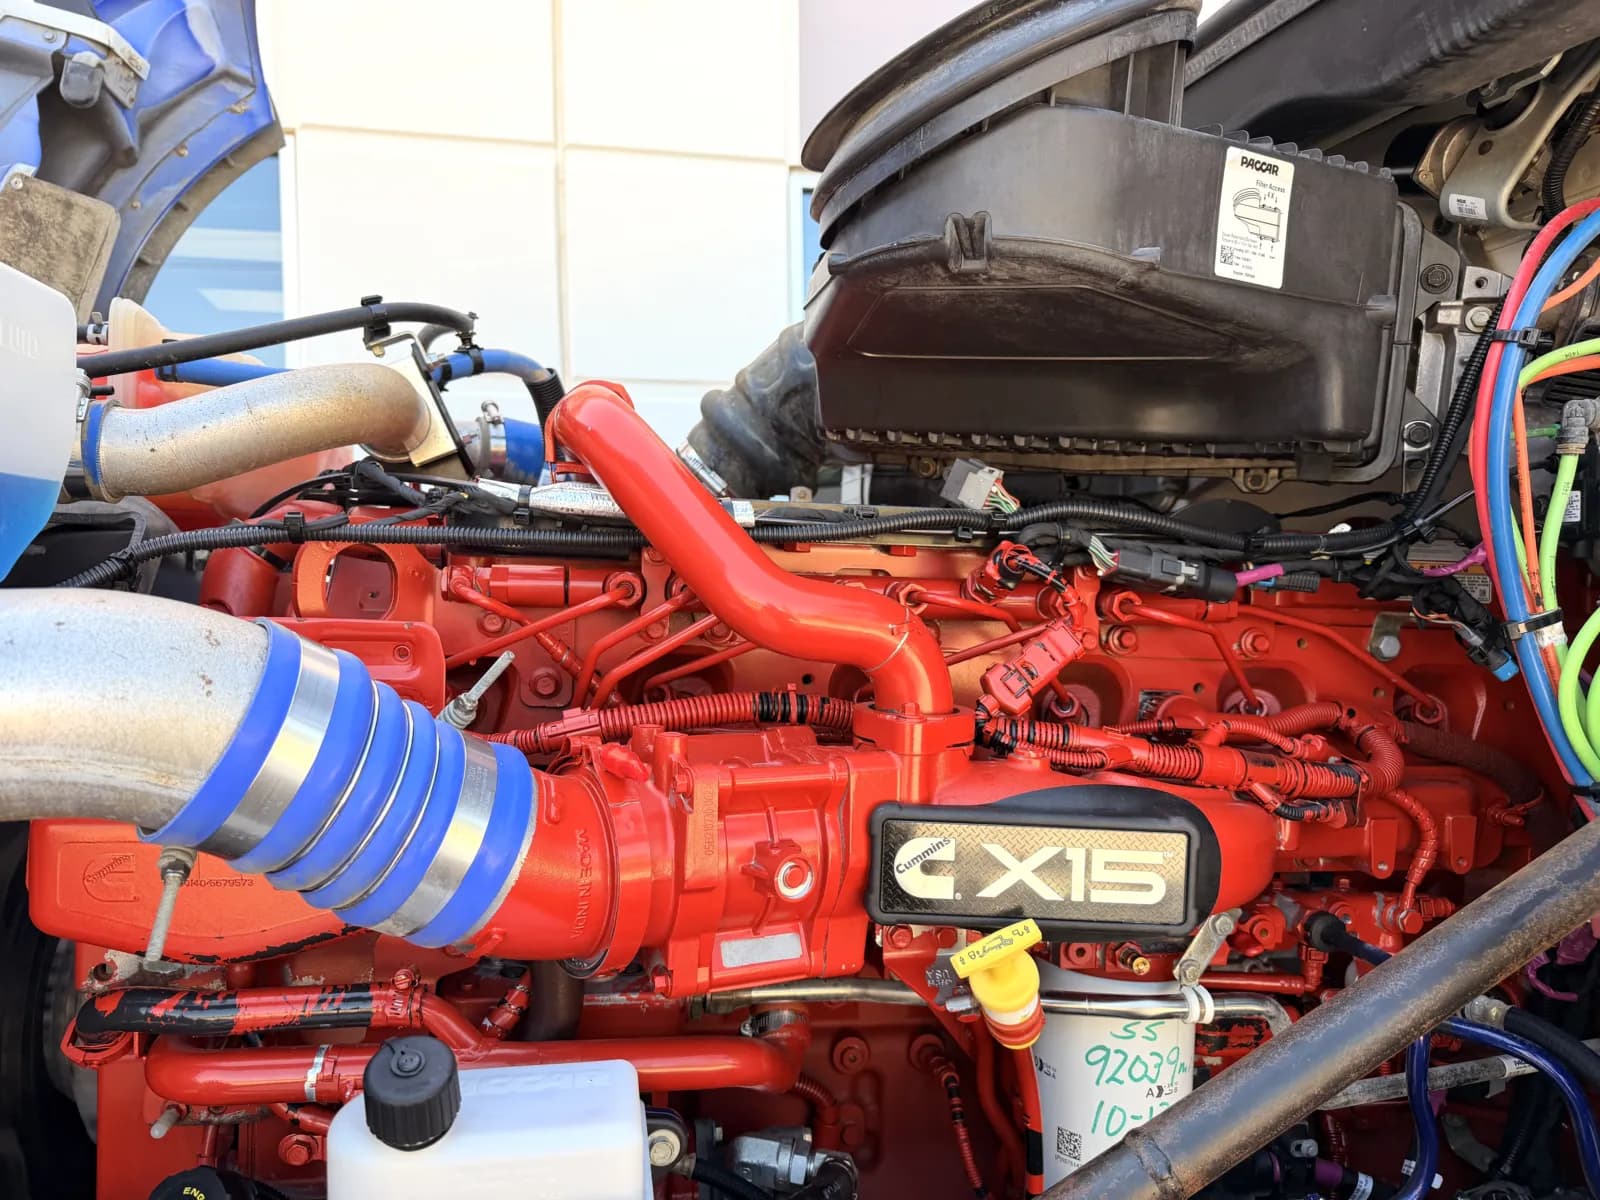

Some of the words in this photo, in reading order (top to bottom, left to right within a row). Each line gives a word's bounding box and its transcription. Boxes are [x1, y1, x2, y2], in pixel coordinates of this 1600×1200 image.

[1240, 156, 1279, 176] PACCAR
[895, 836, 952, 875] Cummins
[976, 843, 1167, 905] X15
